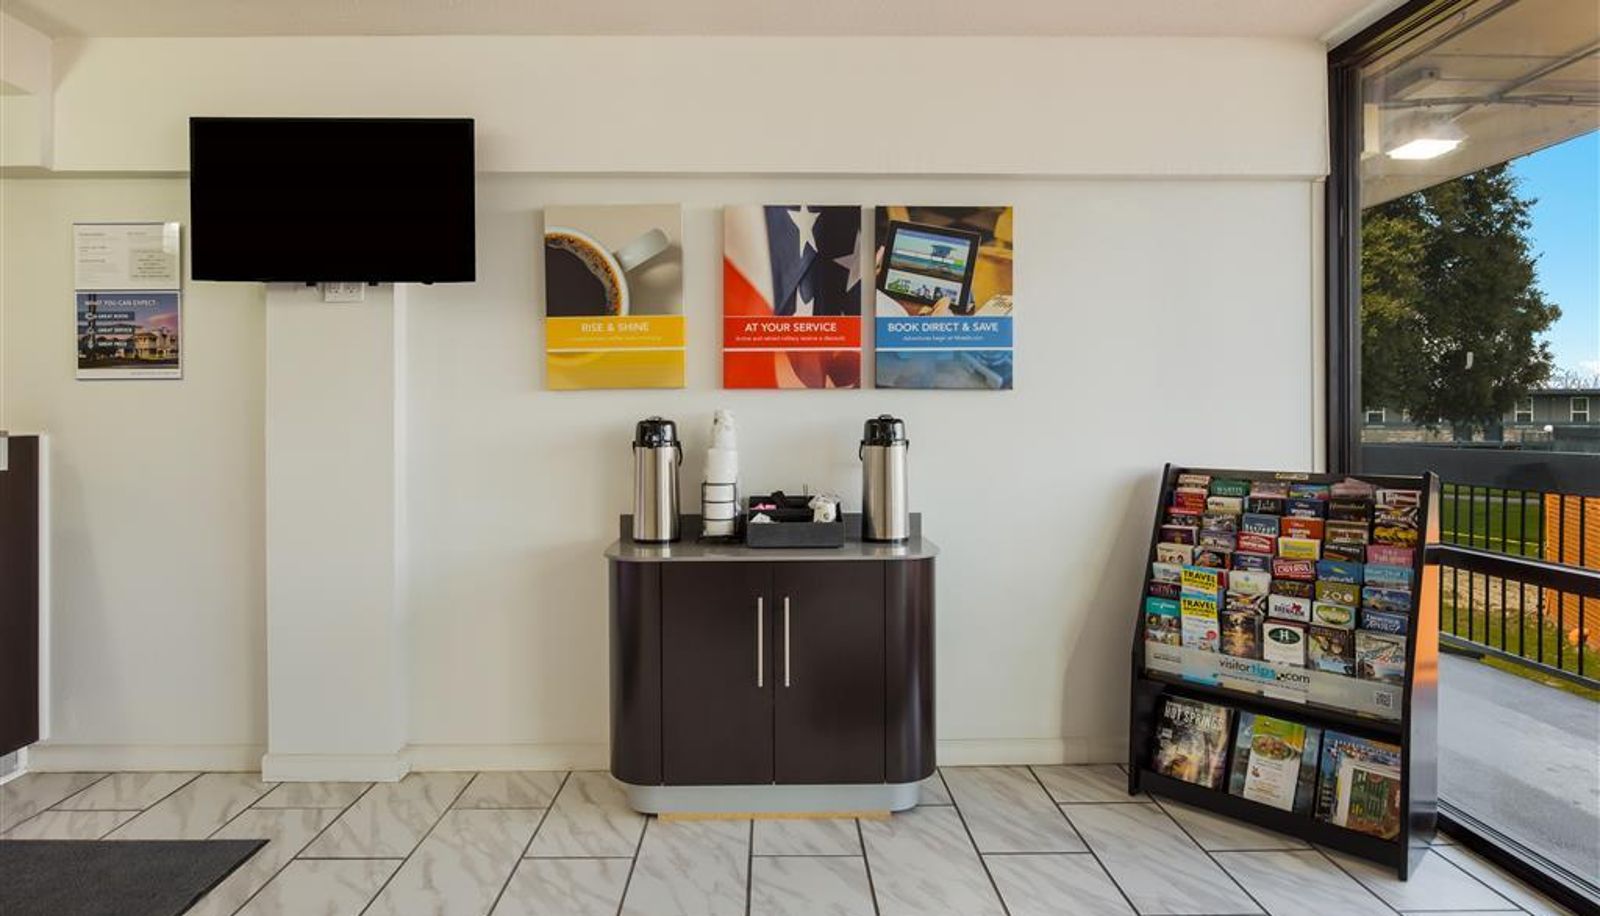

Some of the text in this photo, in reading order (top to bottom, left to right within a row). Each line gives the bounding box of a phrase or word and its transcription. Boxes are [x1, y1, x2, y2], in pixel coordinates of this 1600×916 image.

[581, 321, 650, 333] RISE & SHINE
[744, 322, 837, 333] AT YOUR SERVICE
[887, 322, 999, 333] BOOK DIRECT & SAVE
[1183, 570, 1216, 583] TRAVEL
[1182, 598, 1215, 610] TRAVEL
[1183, 708, 1225, 731] SPRINGS
